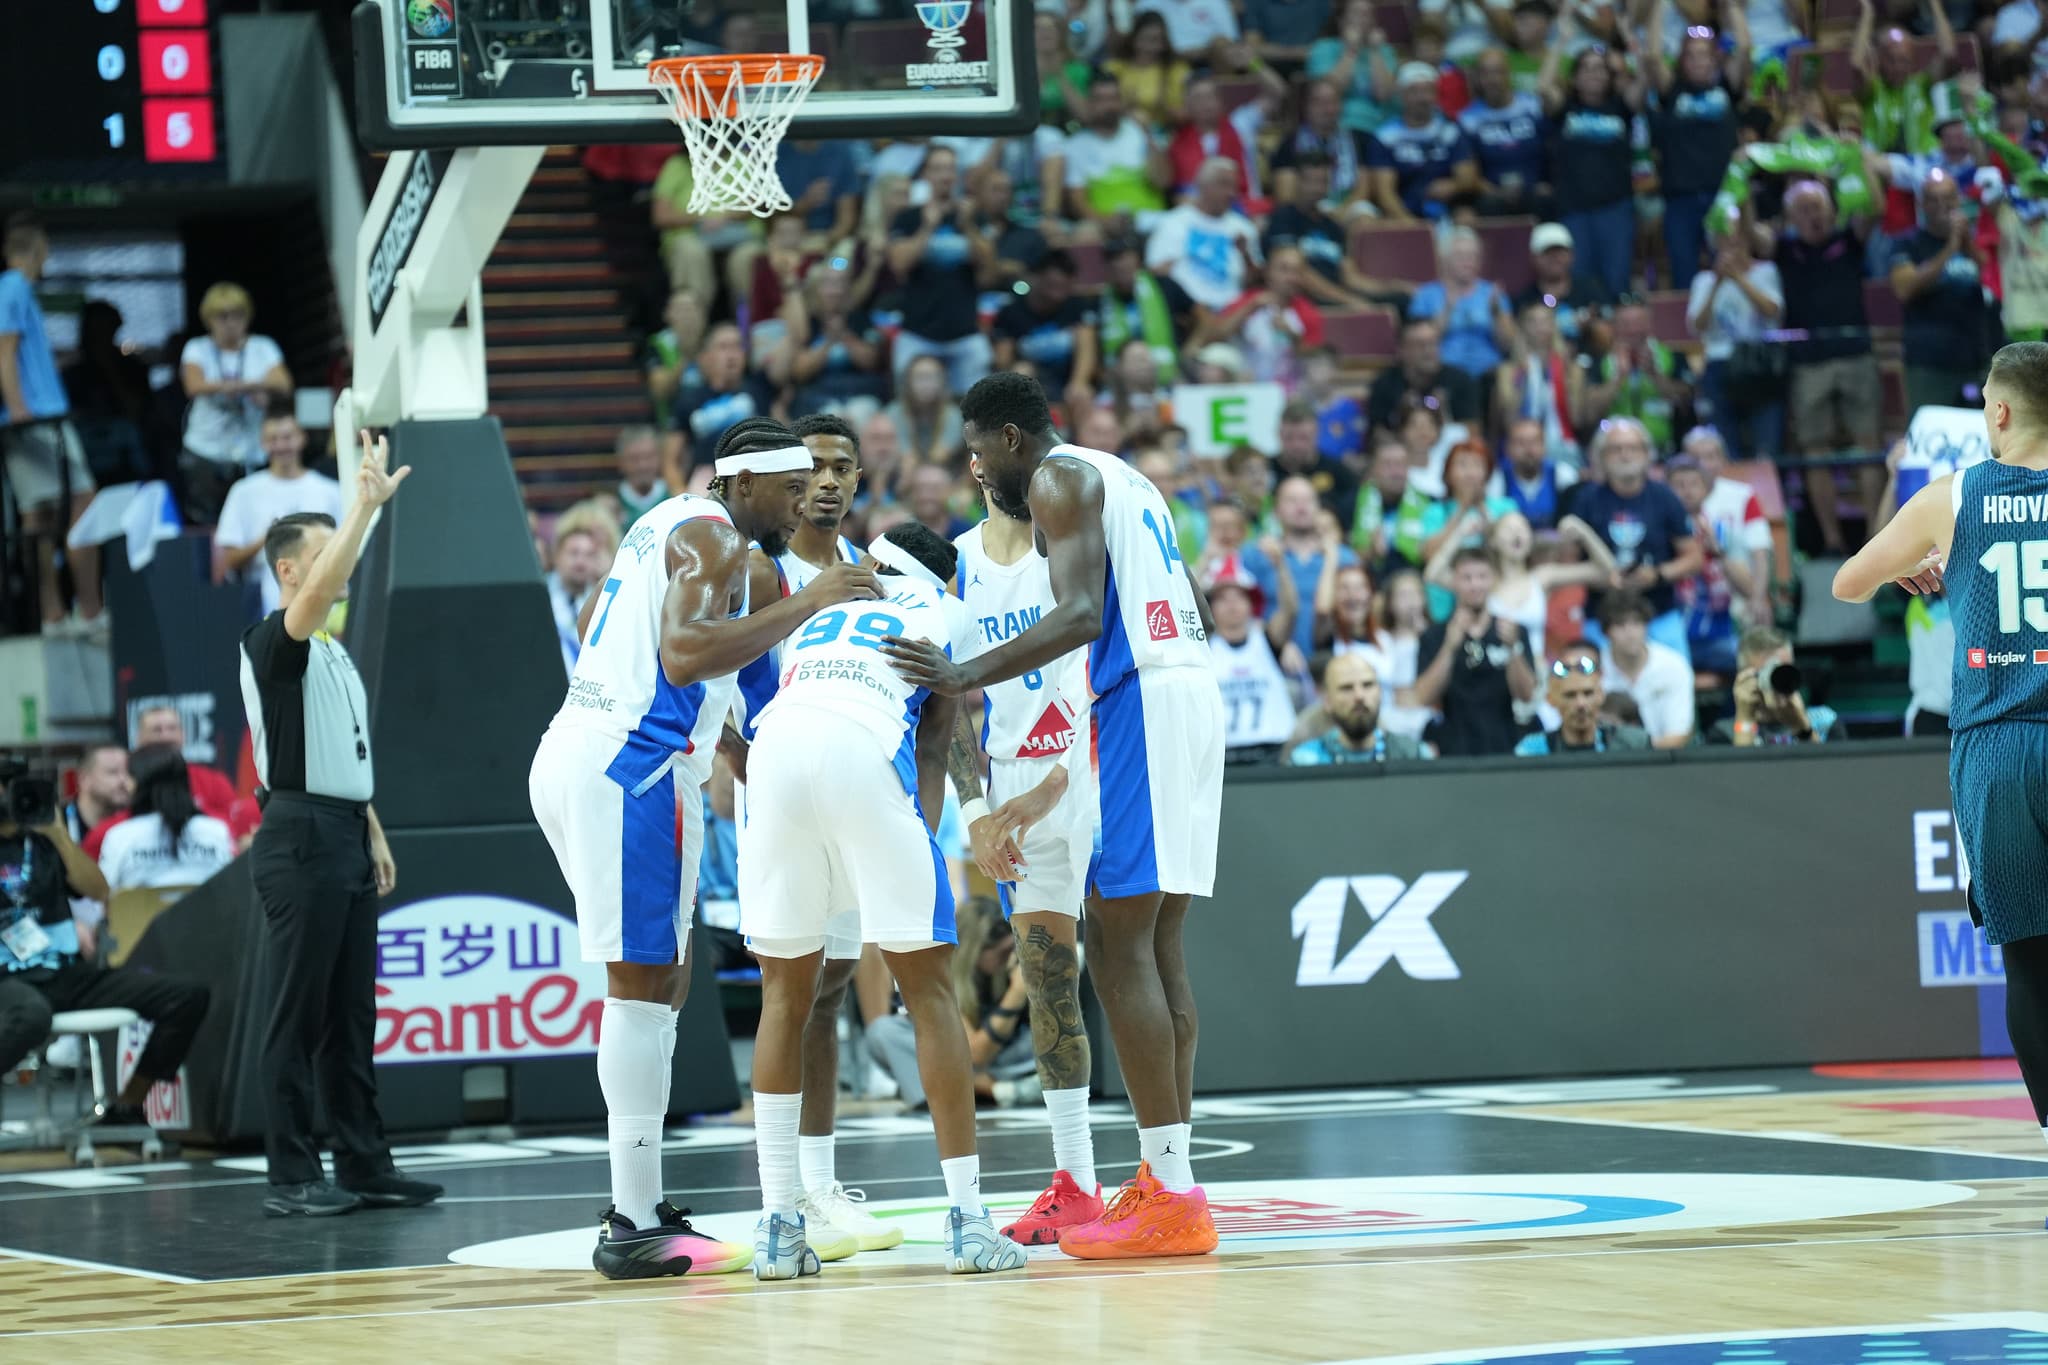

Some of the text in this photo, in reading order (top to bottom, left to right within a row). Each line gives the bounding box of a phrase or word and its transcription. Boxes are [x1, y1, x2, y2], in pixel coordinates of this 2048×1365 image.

[97, 43, 189, 81] 0 0
[414, 50, 452, 69] FIBA
[906, 62, 988, 79] EUROBASKET
[103, 112, 193, 148] 1 5
[1210, 397, 1247, 446] E
[1978, 540, 2048, 634] 15
[590, 577, 622, 647] 7
[795, 609, 905, 651] 99
[801, 659, 869, 672] CAISSE
[1987, 651, 2027, 667] triglav
[798, 668, 897, 701] D'EPARGNE
[377, 922, 561, 979] 百岁山
